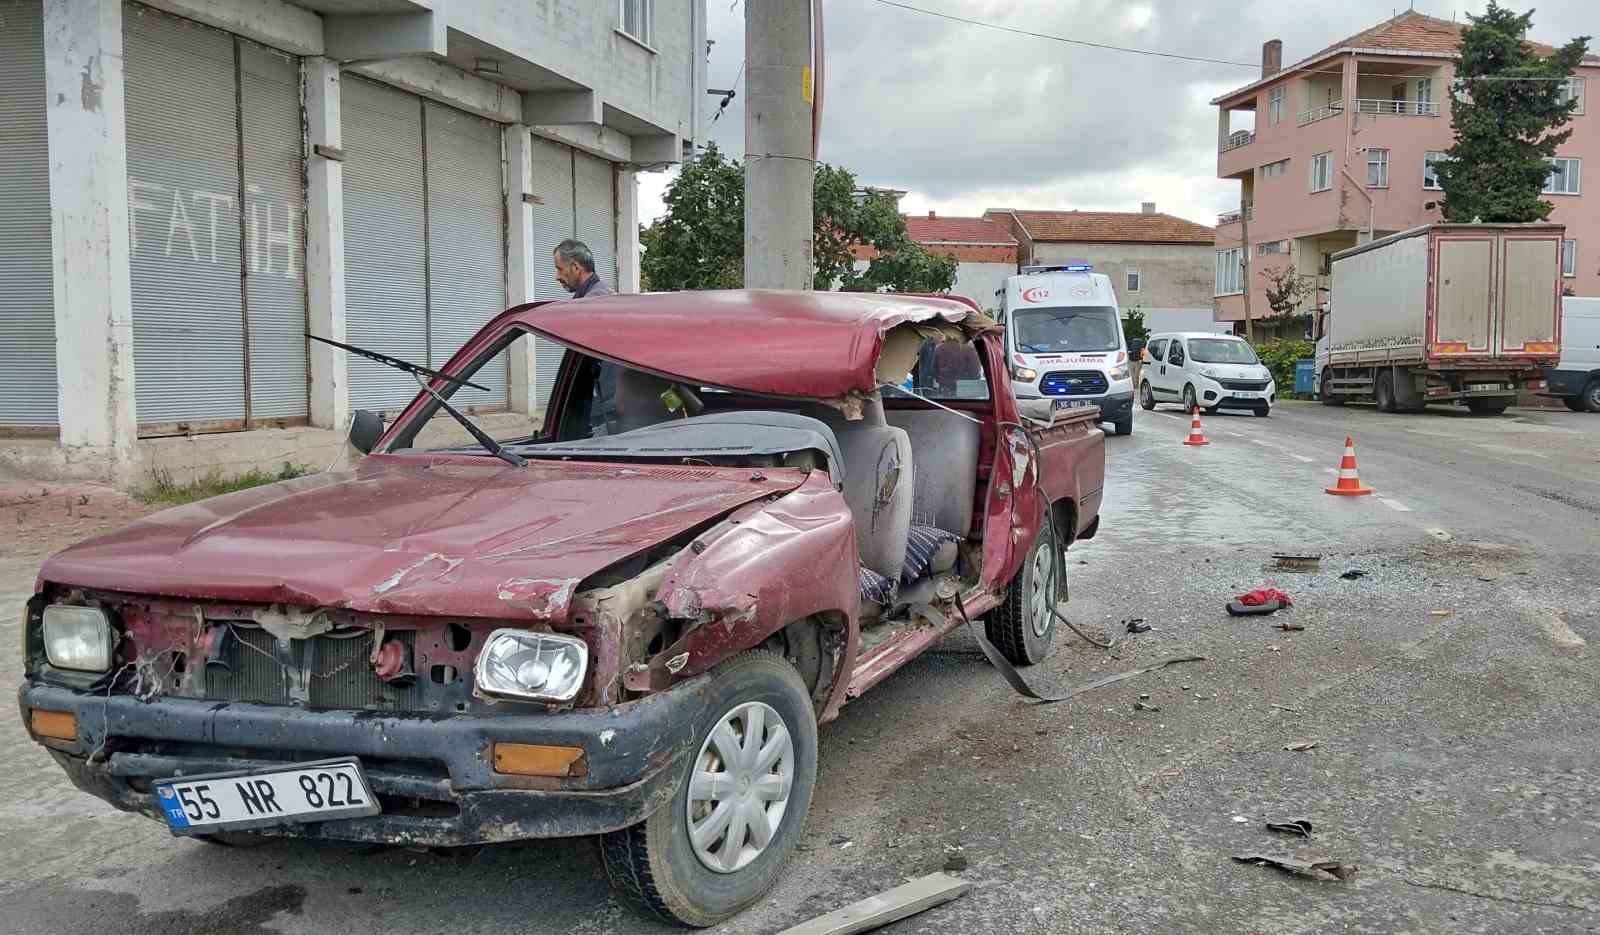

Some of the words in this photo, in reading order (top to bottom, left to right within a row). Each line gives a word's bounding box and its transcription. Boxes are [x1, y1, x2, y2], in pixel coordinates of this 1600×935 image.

[1032, 290, 1048, 298] 112
[178, 785, 220, 820] 55
[236, 780, 282, 814] NR
[299, 773, 363, 808] 822
[170, 808, 184, 818] TR
